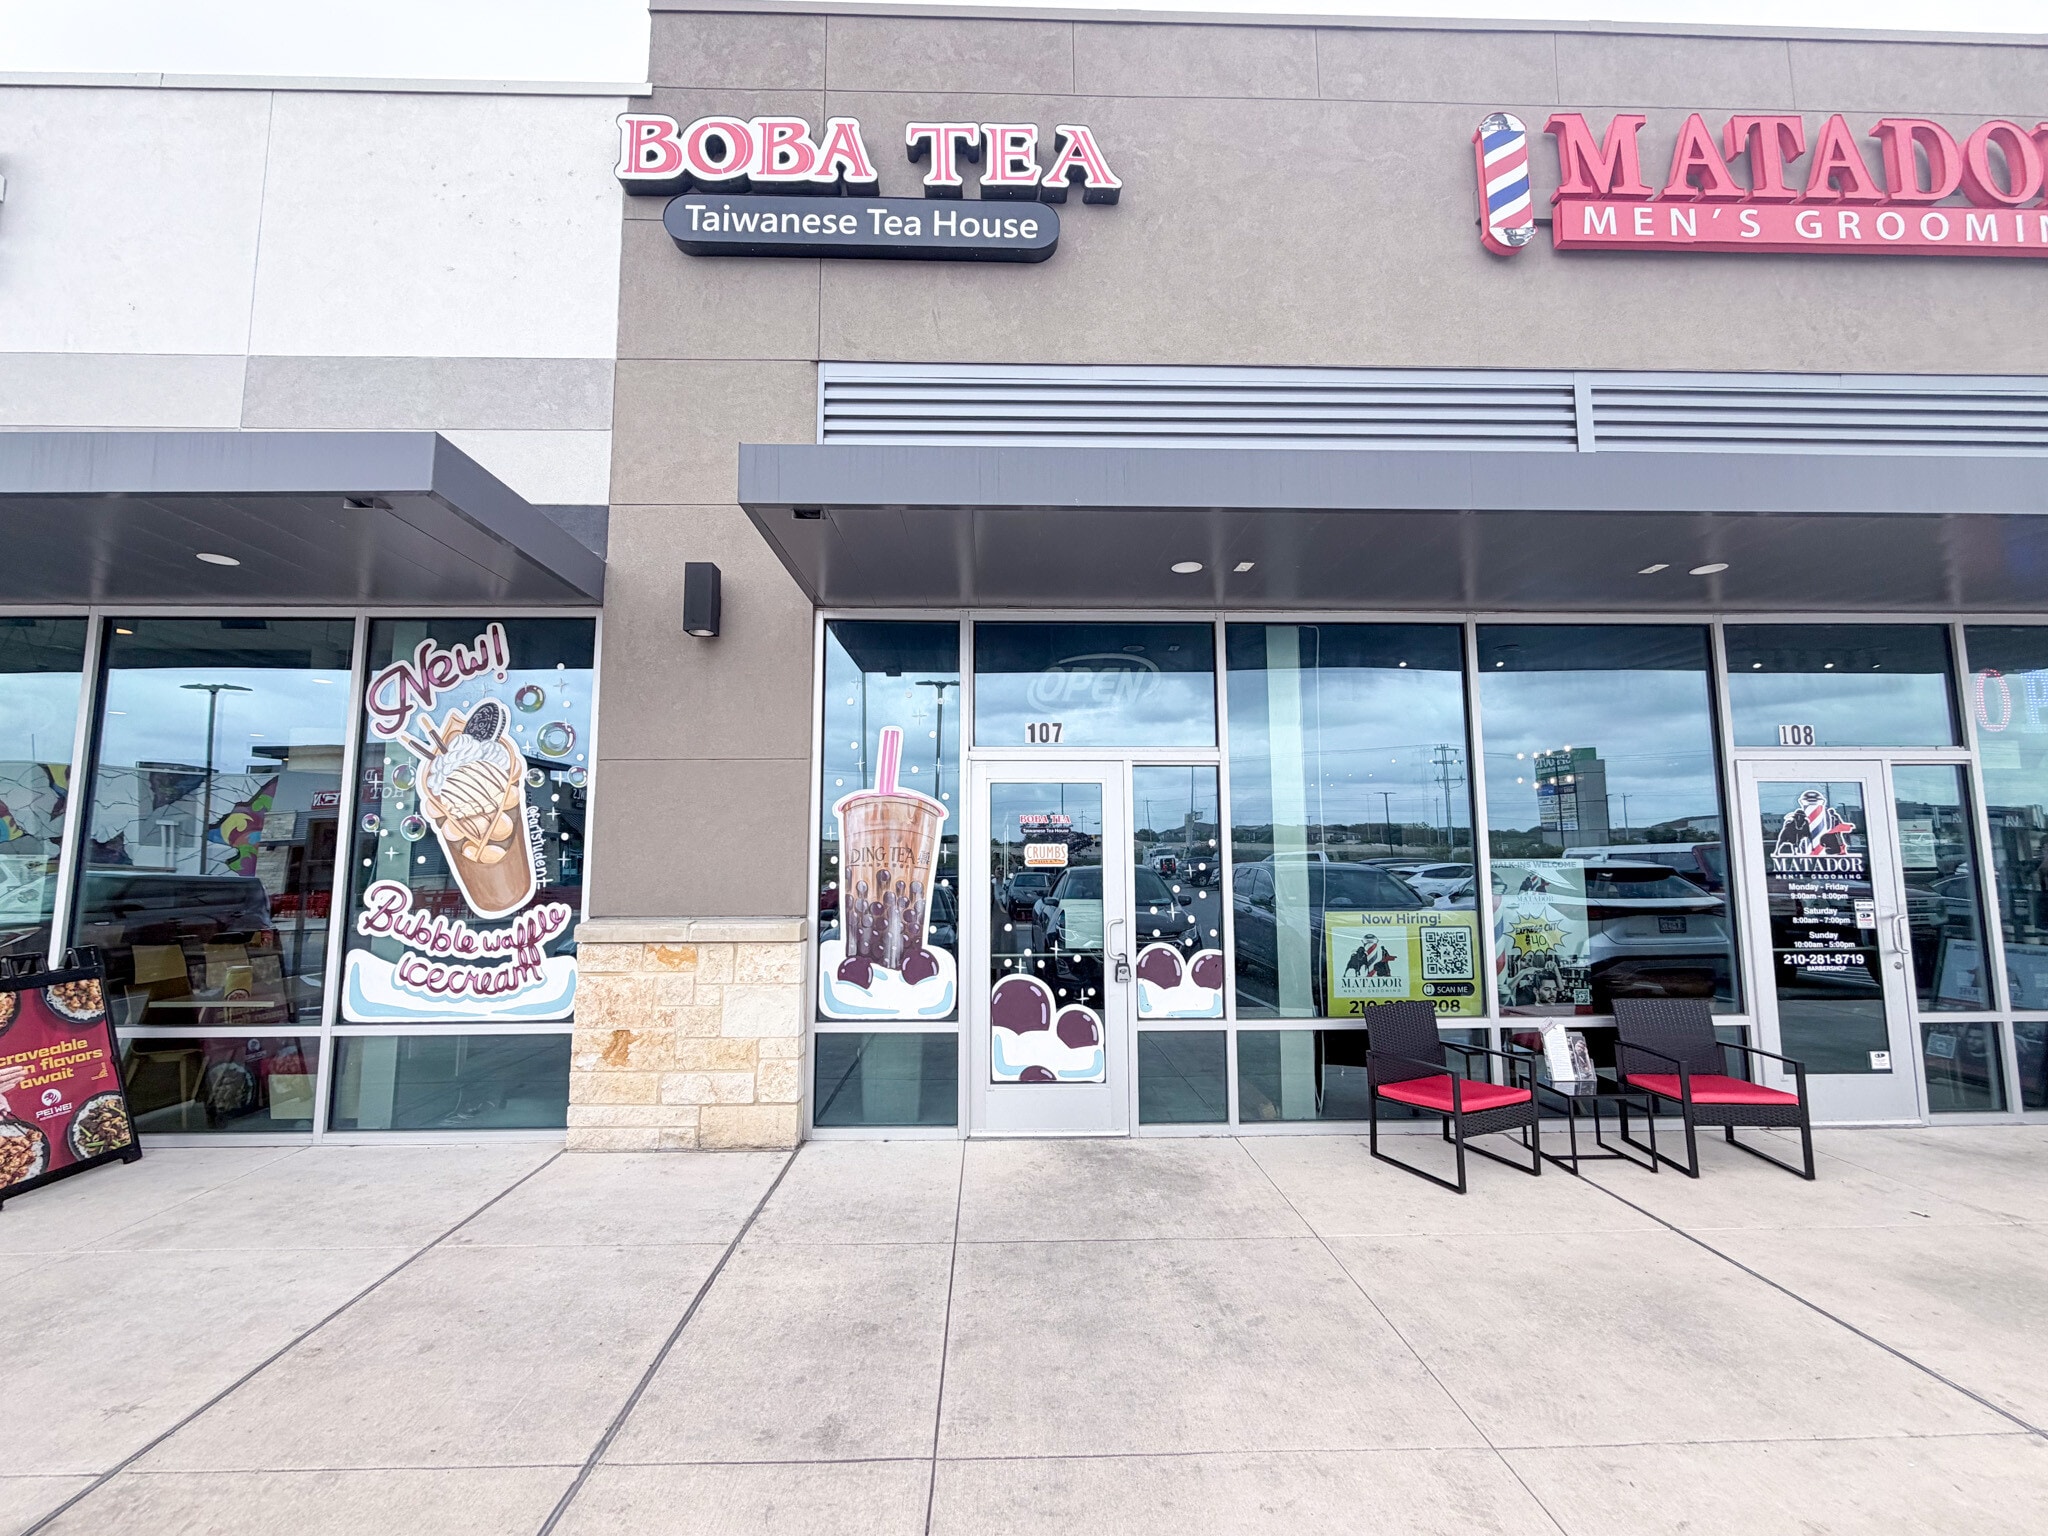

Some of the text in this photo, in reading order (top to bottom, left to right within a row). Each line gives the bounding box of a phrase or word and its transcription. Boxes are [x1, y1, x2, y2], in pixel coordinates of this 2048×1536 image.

[615, 113, 1123, 189] BOBA TEA
[1543, 113, 2048, 207] MATADO
[685, 204, 1039, 239] Taiwanese Tea House
[1583, 207, 1762, 238] MEN'S
[369, 624, 504, 735] New!
[1036, 666, 1148, 702] OPEN
[1027, 722, 1063, 744] 107
[1781, 724, 1814, 746] 108
[1019, 814, 1072, 823] BOBA TEA
[850, 846, 886, 864] DING
[890, 846, 915, 864] TEA
[1027, 845, 1066, 859] CRUMBS
[1533, 861, 1577, 869] WELCOME
[1772, 858, 1864, 873] MATADOR
[1788, 883, 1819, 892] Monday
[1825, 883, 1849, 892] Friday
[1822, 893, 1849, 901] 8:00pm
[1803, 907, 1838, 916] Saturday
[364, 885, 566, 967] Bubble waffle
[1362, 914, 1441, 926] Now Hiring!
[1824, 917, 1851, 925] 7:00pm
[1809, 931, 1839, 940] Sunday
[1829, 941, 1856, 949] 5:00pm
[1783, 954, 1865, 965] 210-281-8719
[1341, 978, 1402, 989] MATADOR
[40, 1048, 103, 1072] flavors
[20, 1069, 75, 1090] await
[36, 1108, 54, 1119] PEI
[54, 1102, 73, 1114] WEI
